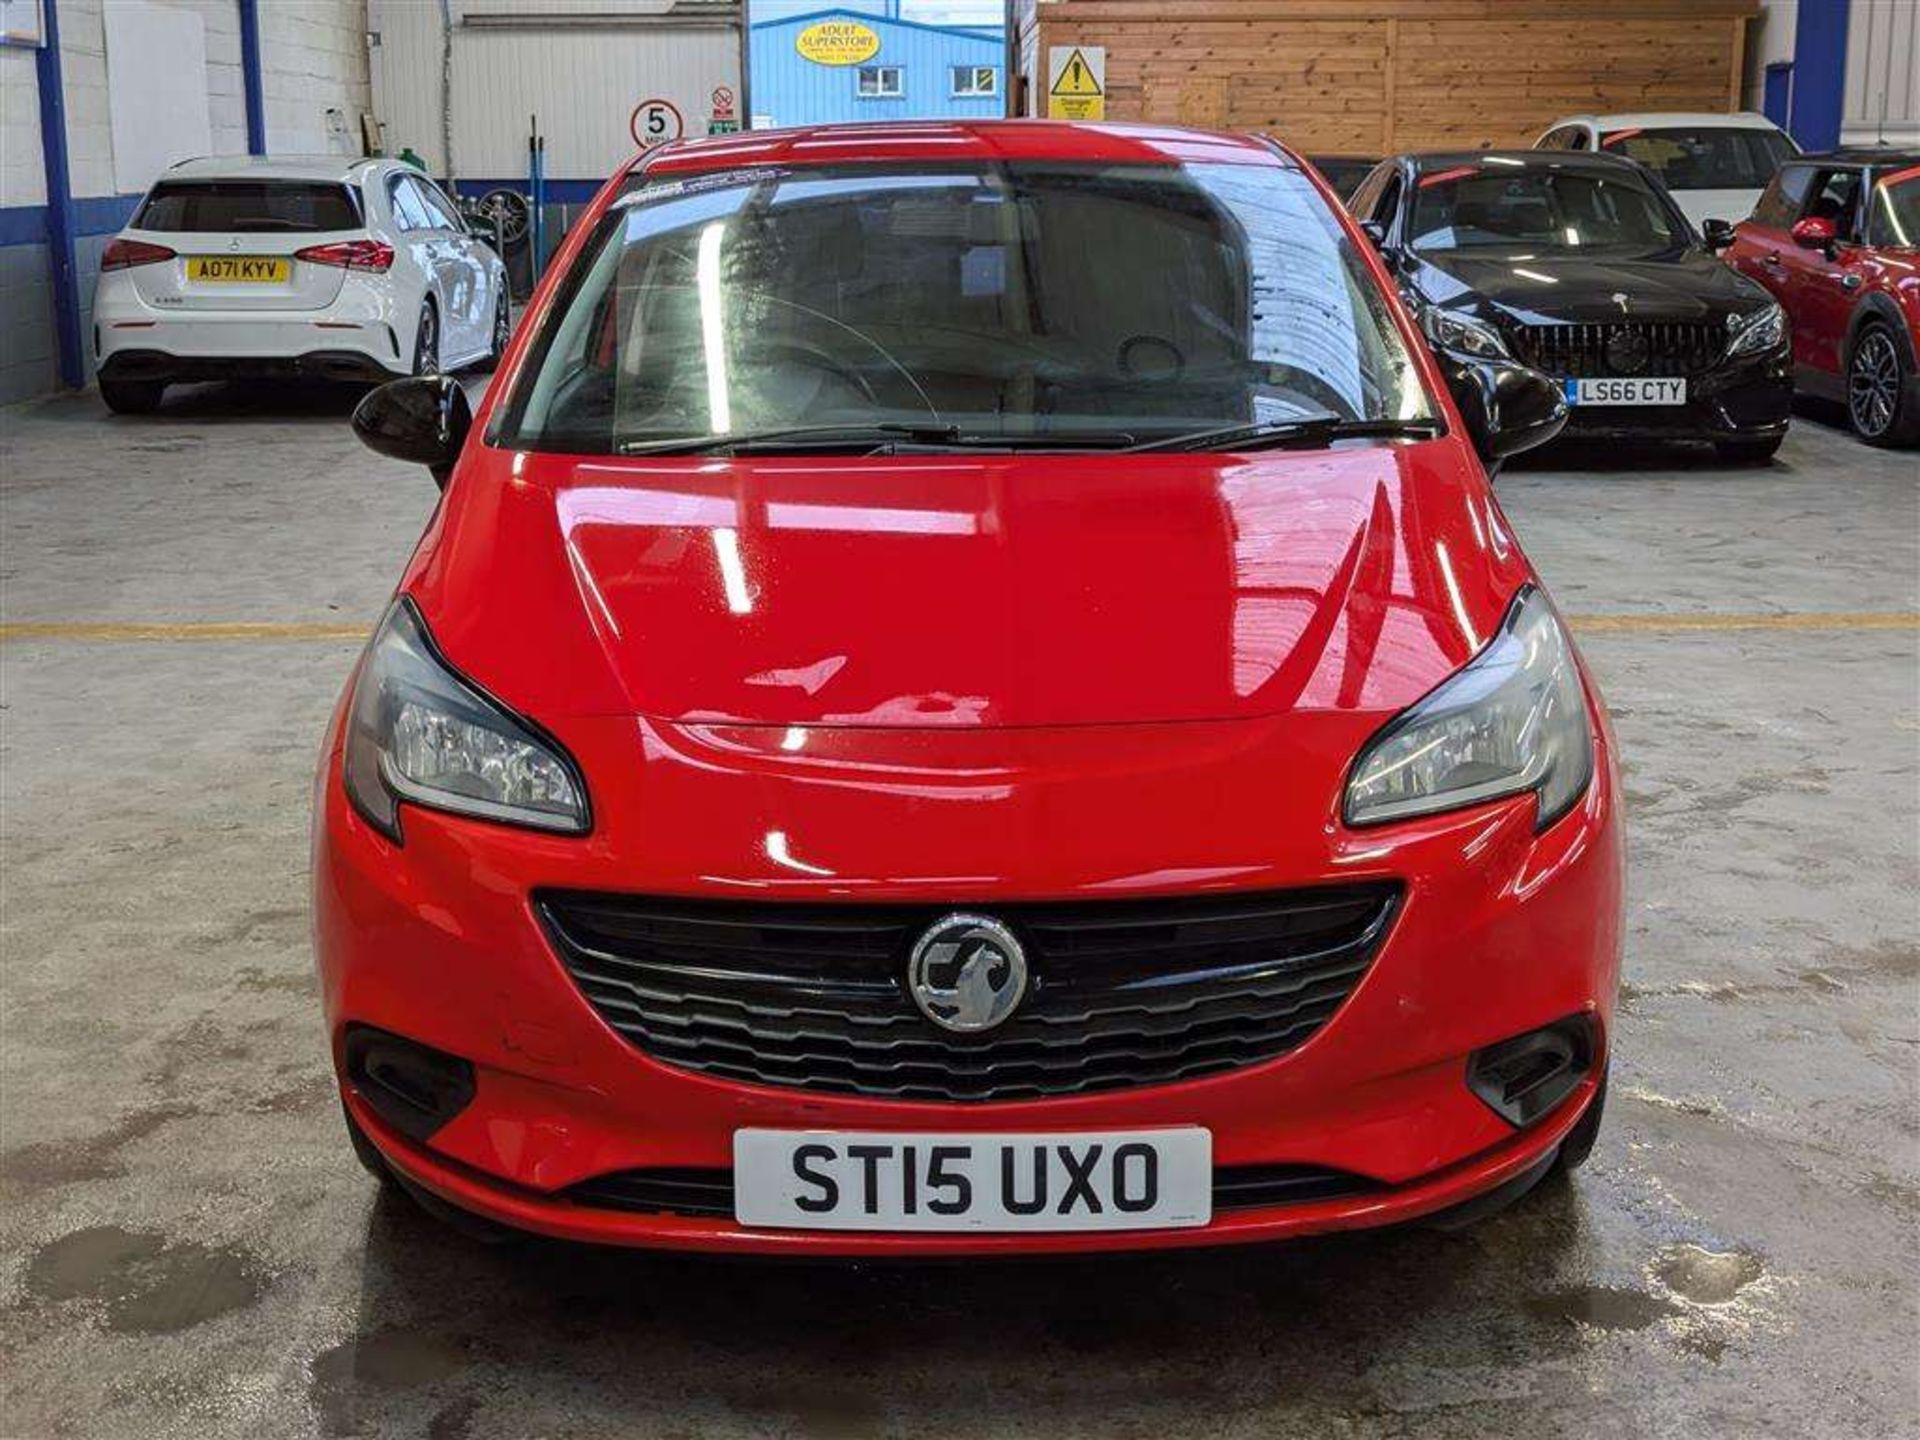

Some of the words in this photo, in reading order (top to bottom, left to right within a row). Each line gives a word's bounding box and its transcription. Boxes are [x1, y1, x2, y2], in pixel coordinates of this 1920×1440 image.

[820, 25, 856, 35] ADULT
[802, 36, 873, 47] SUPERSTORE
[648, 107, 665, 133] 5
[242, 260, 277, 277] KYV
[1581, 382, 1637, 401] LS66
[1642, 382, 1681, 401] CTY
[792, 1143, 973, 1216] ST15
[1001, 1142, 1159, 1216] UXO
